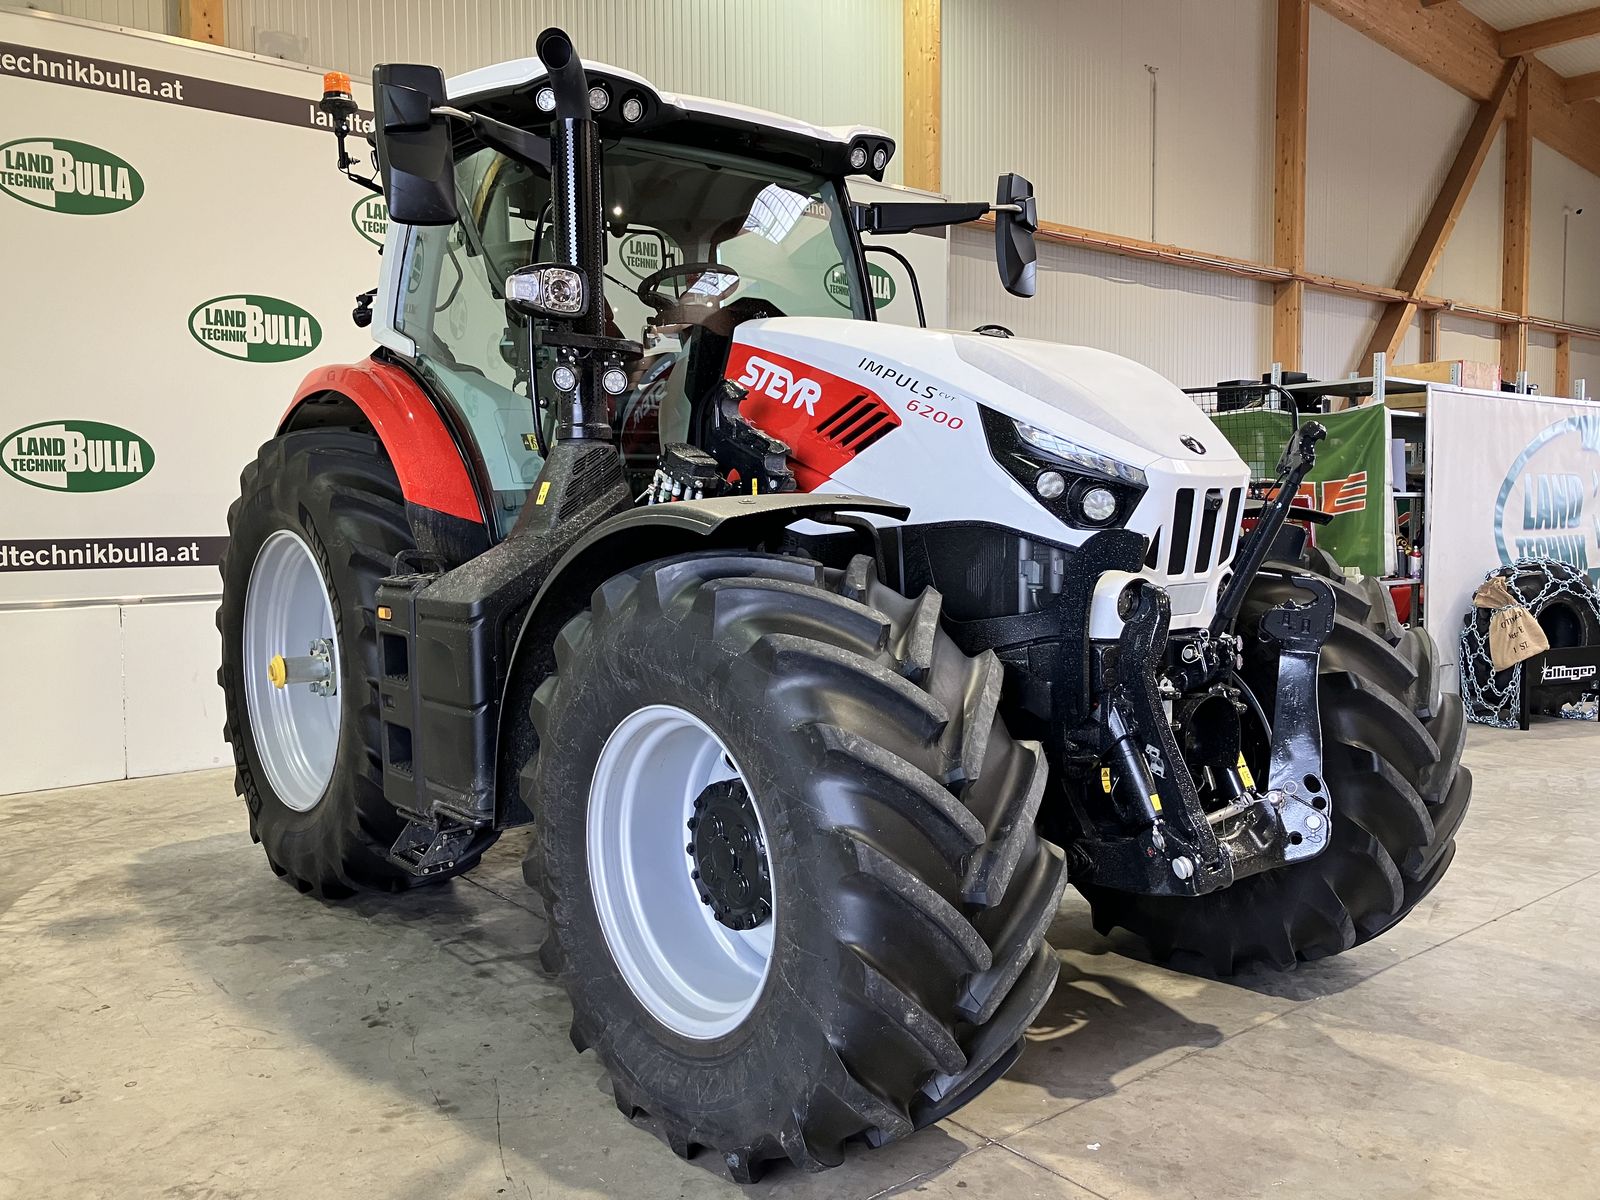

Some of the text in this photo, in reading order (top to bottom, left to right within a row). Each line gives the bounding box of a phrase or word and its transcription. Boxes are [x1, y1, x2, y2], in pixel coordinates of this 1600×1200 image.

[0, 53, 184, 101] echnikbulla.at
[5, 149, 54, 175] LAND
[1, 171, 56, 191] TECHNIK
[52, 149, 133, 201] BULLA
[366, 202, 388, 221] LAN
[804, 202, 826, 216] and
[362, 220, 388, 234] TECH
[630, 240, 658, 257] LAND
[626, 256, 659, 269] TECHNIK
[205, 308, 247, 328] LAND
[245, 304, 312, 347] BULLA
[200, 327, 248, 343] TECHNIK
[738, 355, 822, 417] STEYR
[857, 357, 939, 399] IMPULS
[906, 399, 964, 430] 6200
[17, 437, 66, 457] LAND
[64, 431, 144, 473] BULLA
[11, 458, 67, 472] TECHNIK
[1523, 473, 1584, 530] LAND
